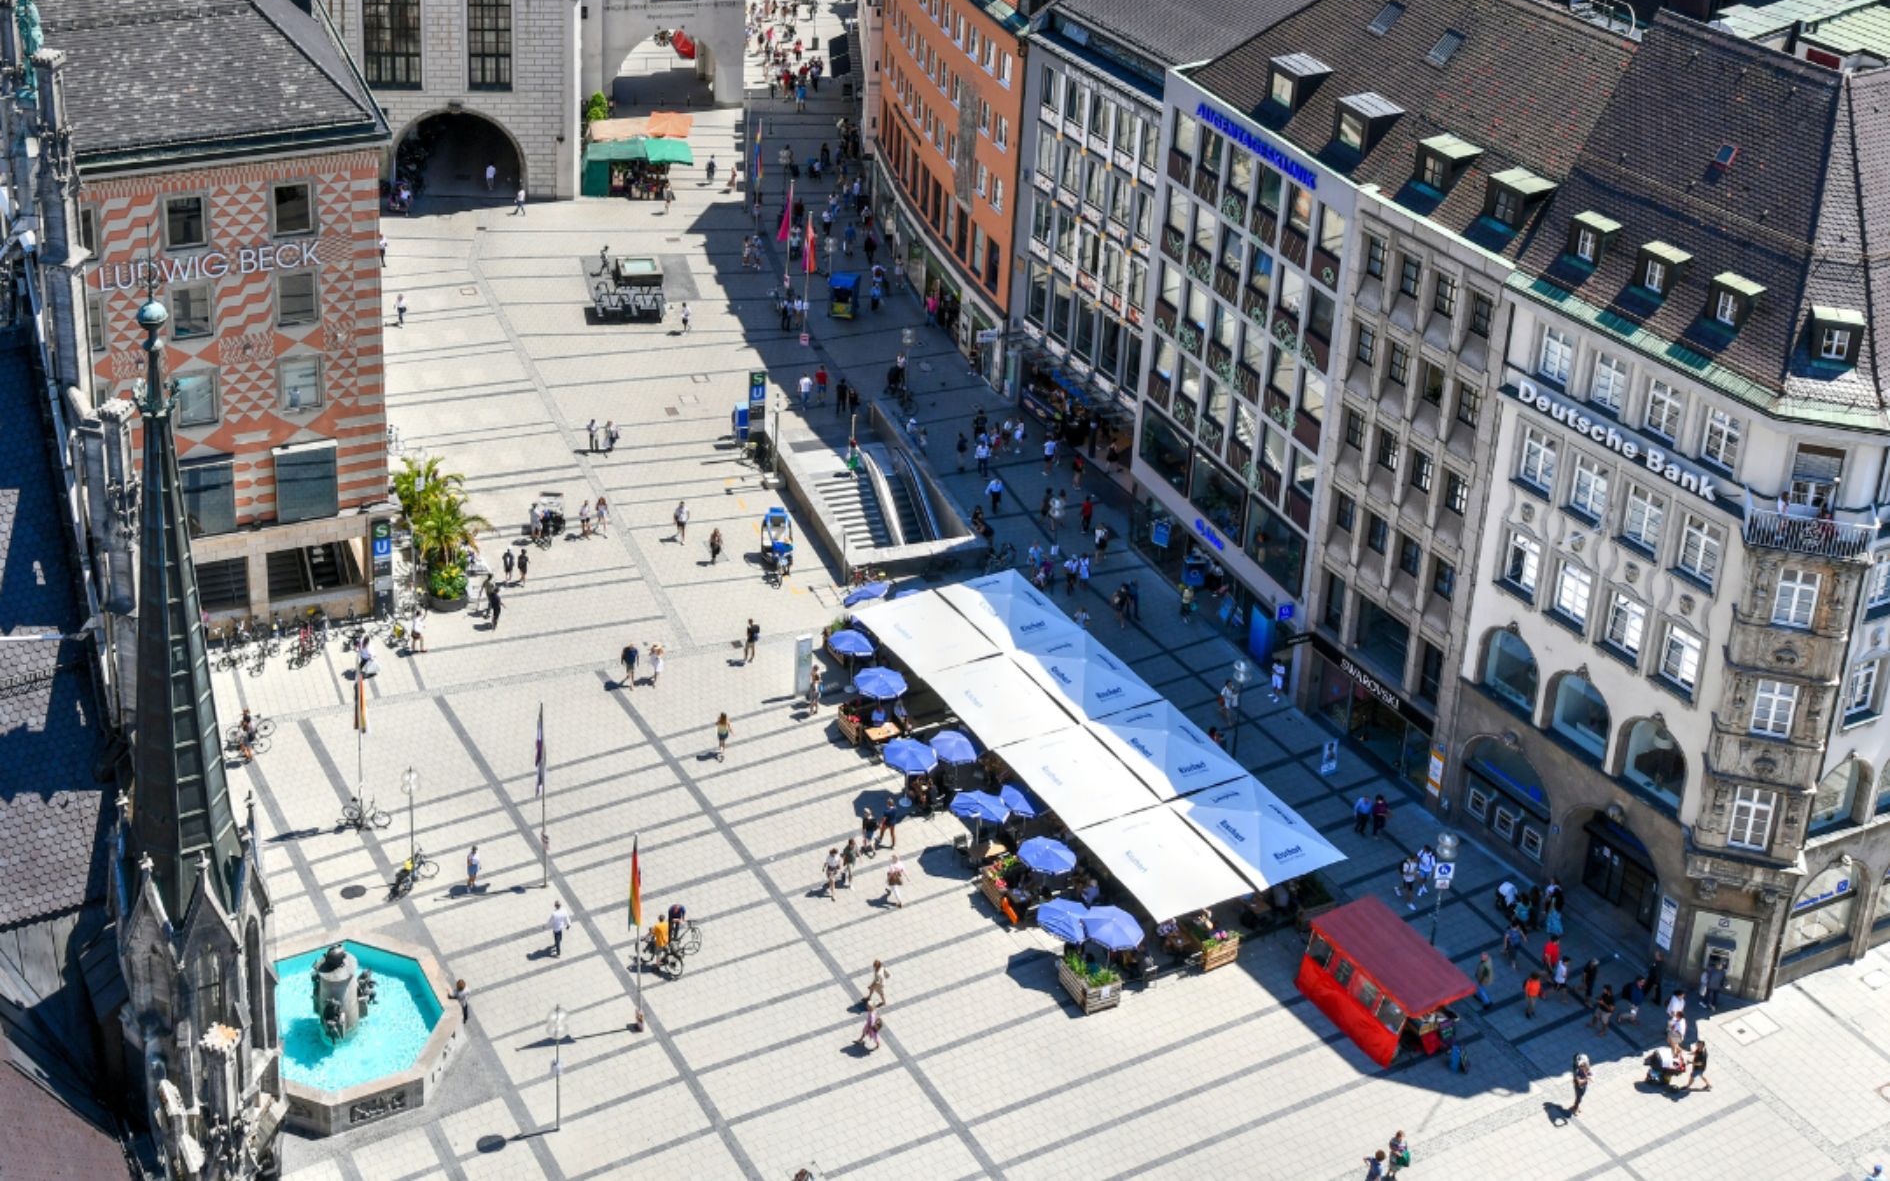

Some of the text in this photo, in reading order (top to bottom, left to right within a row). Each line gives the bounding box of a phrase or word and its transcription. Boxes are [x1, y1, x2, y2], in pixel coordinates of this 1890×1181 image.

[100, 240, 322, 292] LUDWIG BECK
[753, 373, 763, 385] S
[753, 387, 762, 398] U
[1518, 380, 1716, 502] Deutsche Bank
[375, 524, 388, 537] S
[375, 540, 388, 553] U
[1341, 658, 1399, 710] SWAROVSKI
